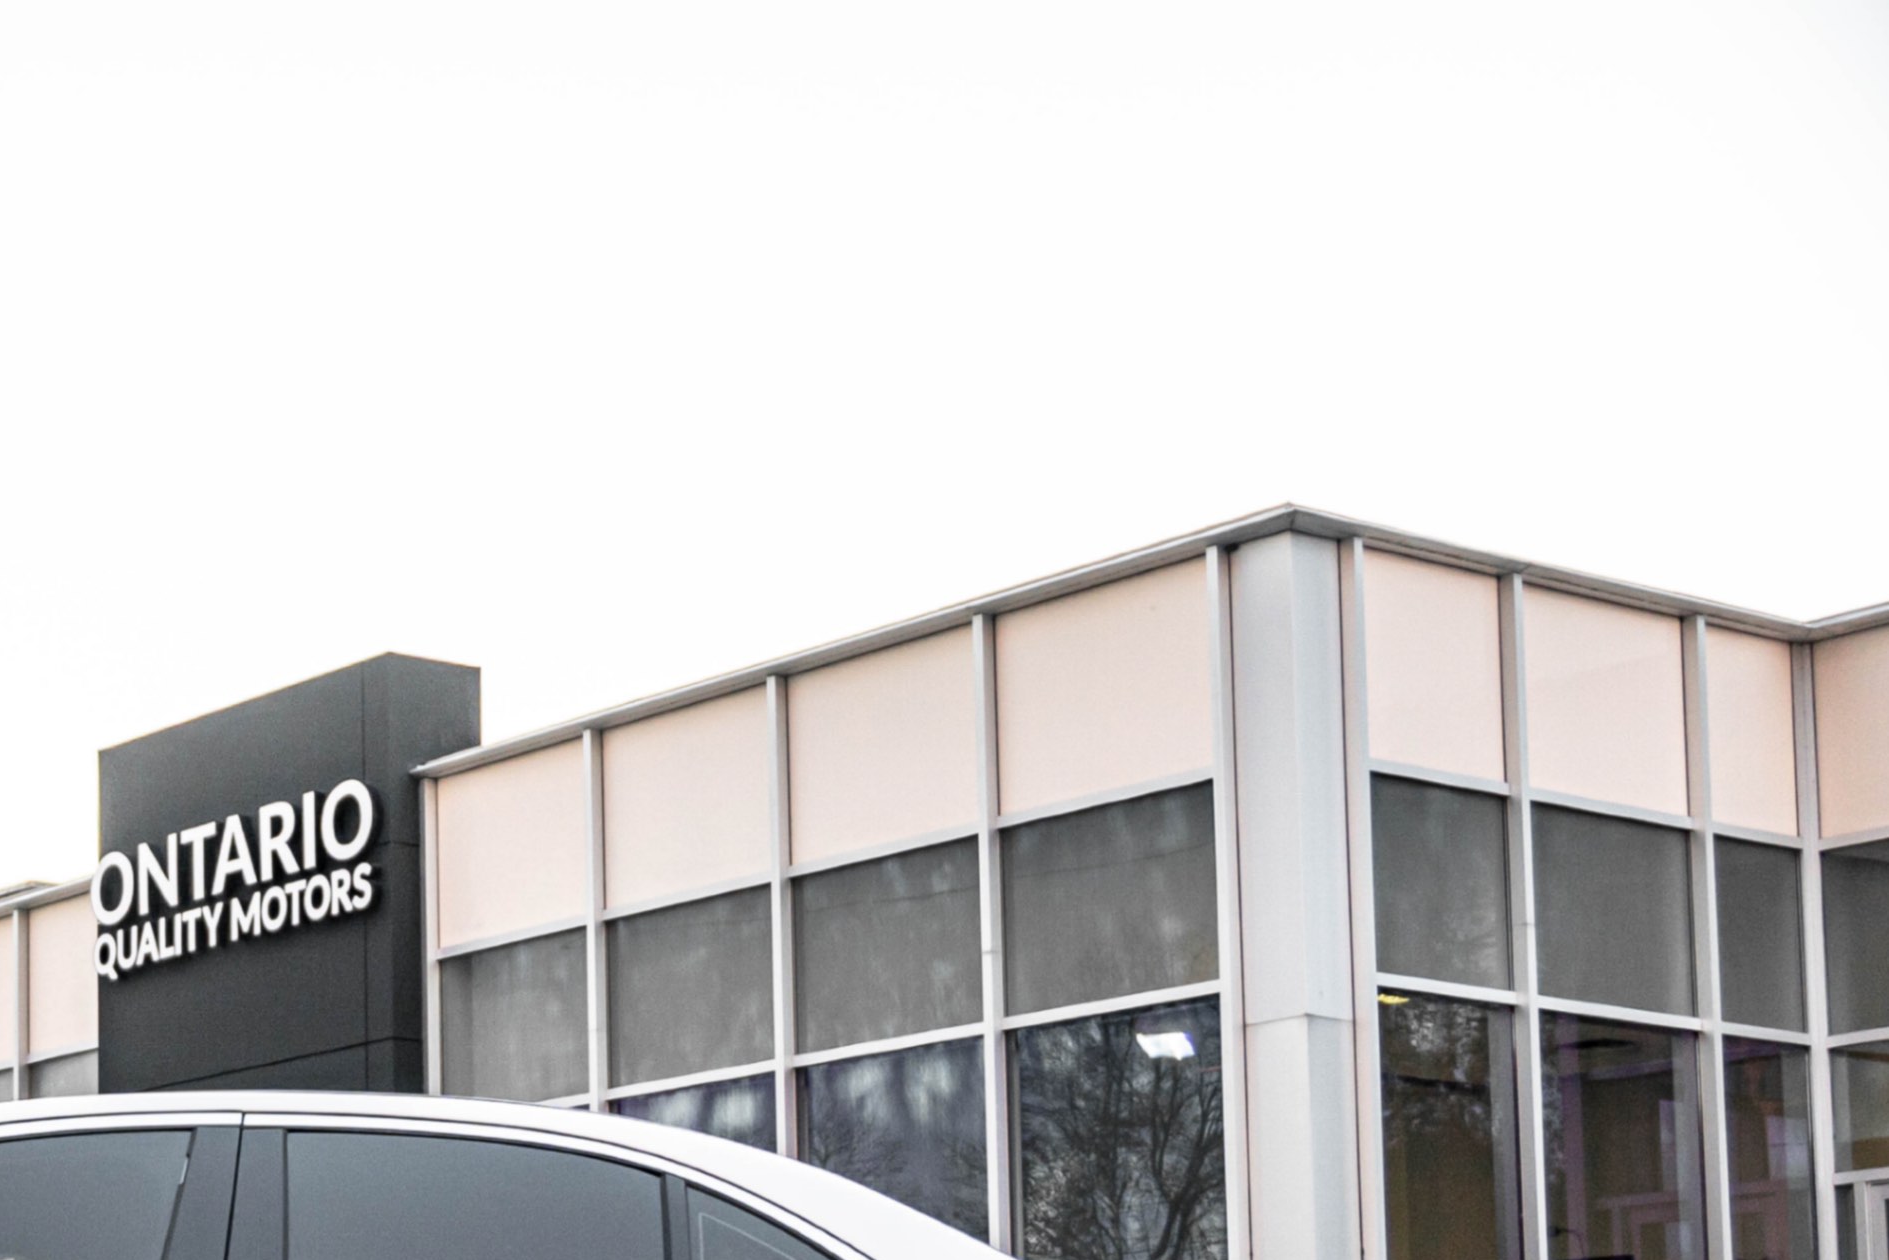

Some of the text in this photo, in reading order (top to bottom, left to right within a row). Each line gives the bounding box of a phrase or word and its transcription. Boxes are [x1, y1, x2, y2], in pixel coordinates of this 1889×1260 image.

[90, 779, 374, 926] ONTARIO
[93, 862, 373, 980] QUALITY MOTORS
